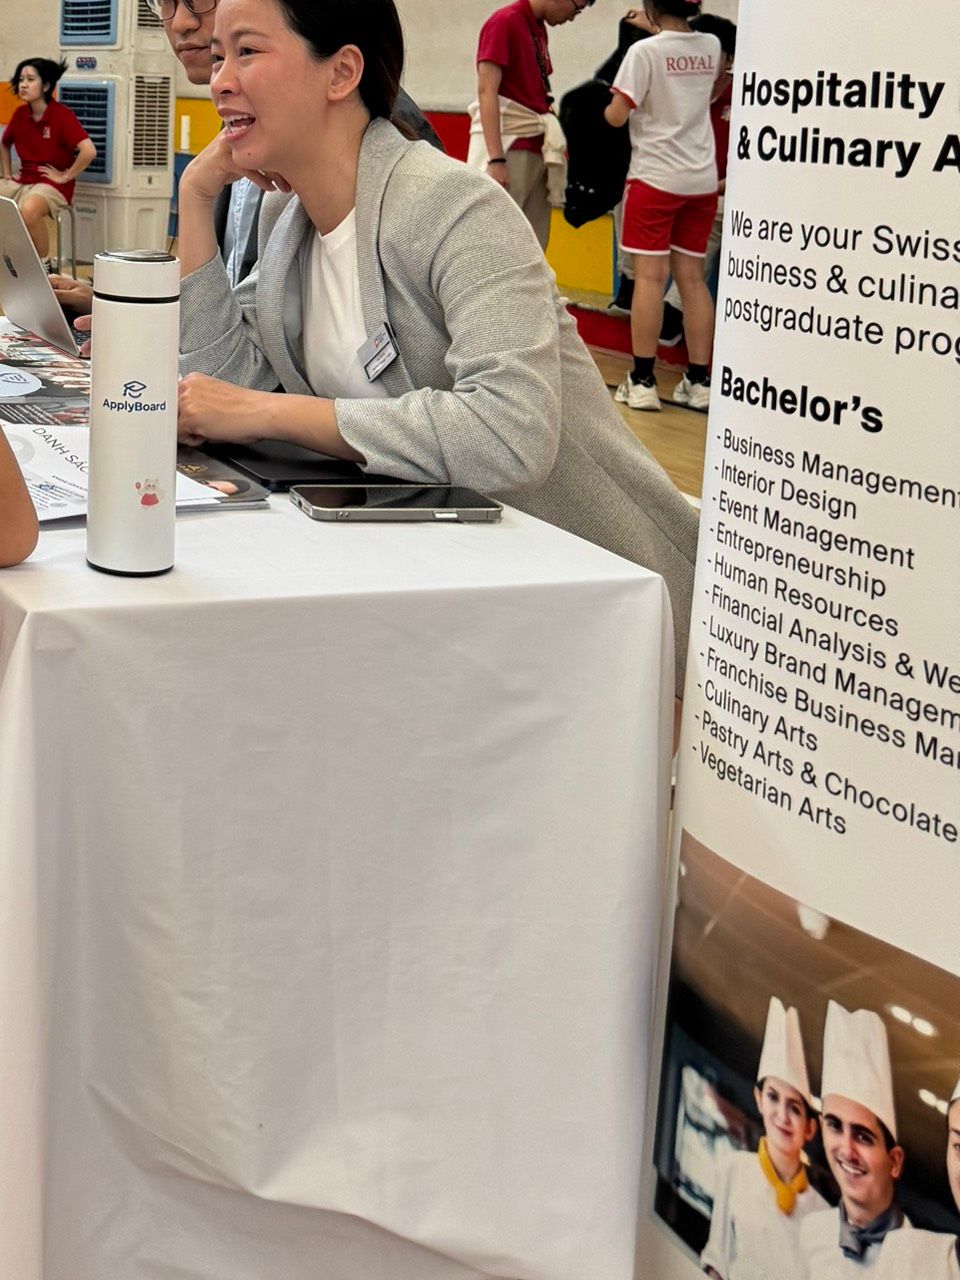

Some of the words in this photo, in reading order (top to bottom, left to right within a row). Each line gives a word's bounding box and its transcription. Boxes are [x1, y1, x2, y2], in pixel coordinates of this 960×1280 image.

[666, 55, 714, 71] ROYAL
[741, 69, 945, 119] Hospitality
[737, 124, 751, 160] &
[757, 125, 921, 178] Culinary
[730, 209, 752, 238] We
[758, 217, 792, 243] are
[800, 223, 862, 252] your
[727, 251, 817, 290] business
[826, 265, 848, 295] &
[858, 272, 959, 310] culina
[724, 295, 884, 345] postgraduate
[102, 398, 166, 413] ApplyBoard
[32, 428, 70, 455] DANH
[781, 479, 857, 520] Design
[764, 505, 916, 571] Management
[775, 576, 899, 638] Resources
[765, 641, 826, 684] Brand
[788, 618, 887, 670] Analysis
[895, 652, 915, 679] &
[774, 715, 818, 752] Arts
[795, 688, 906, 749] Business
[753, 740, 794, 777] Arts
[801, 762, 818, 788] &
[825, 771, 958, 843] Chocolate
[798, 796, 847, 835] Arts
